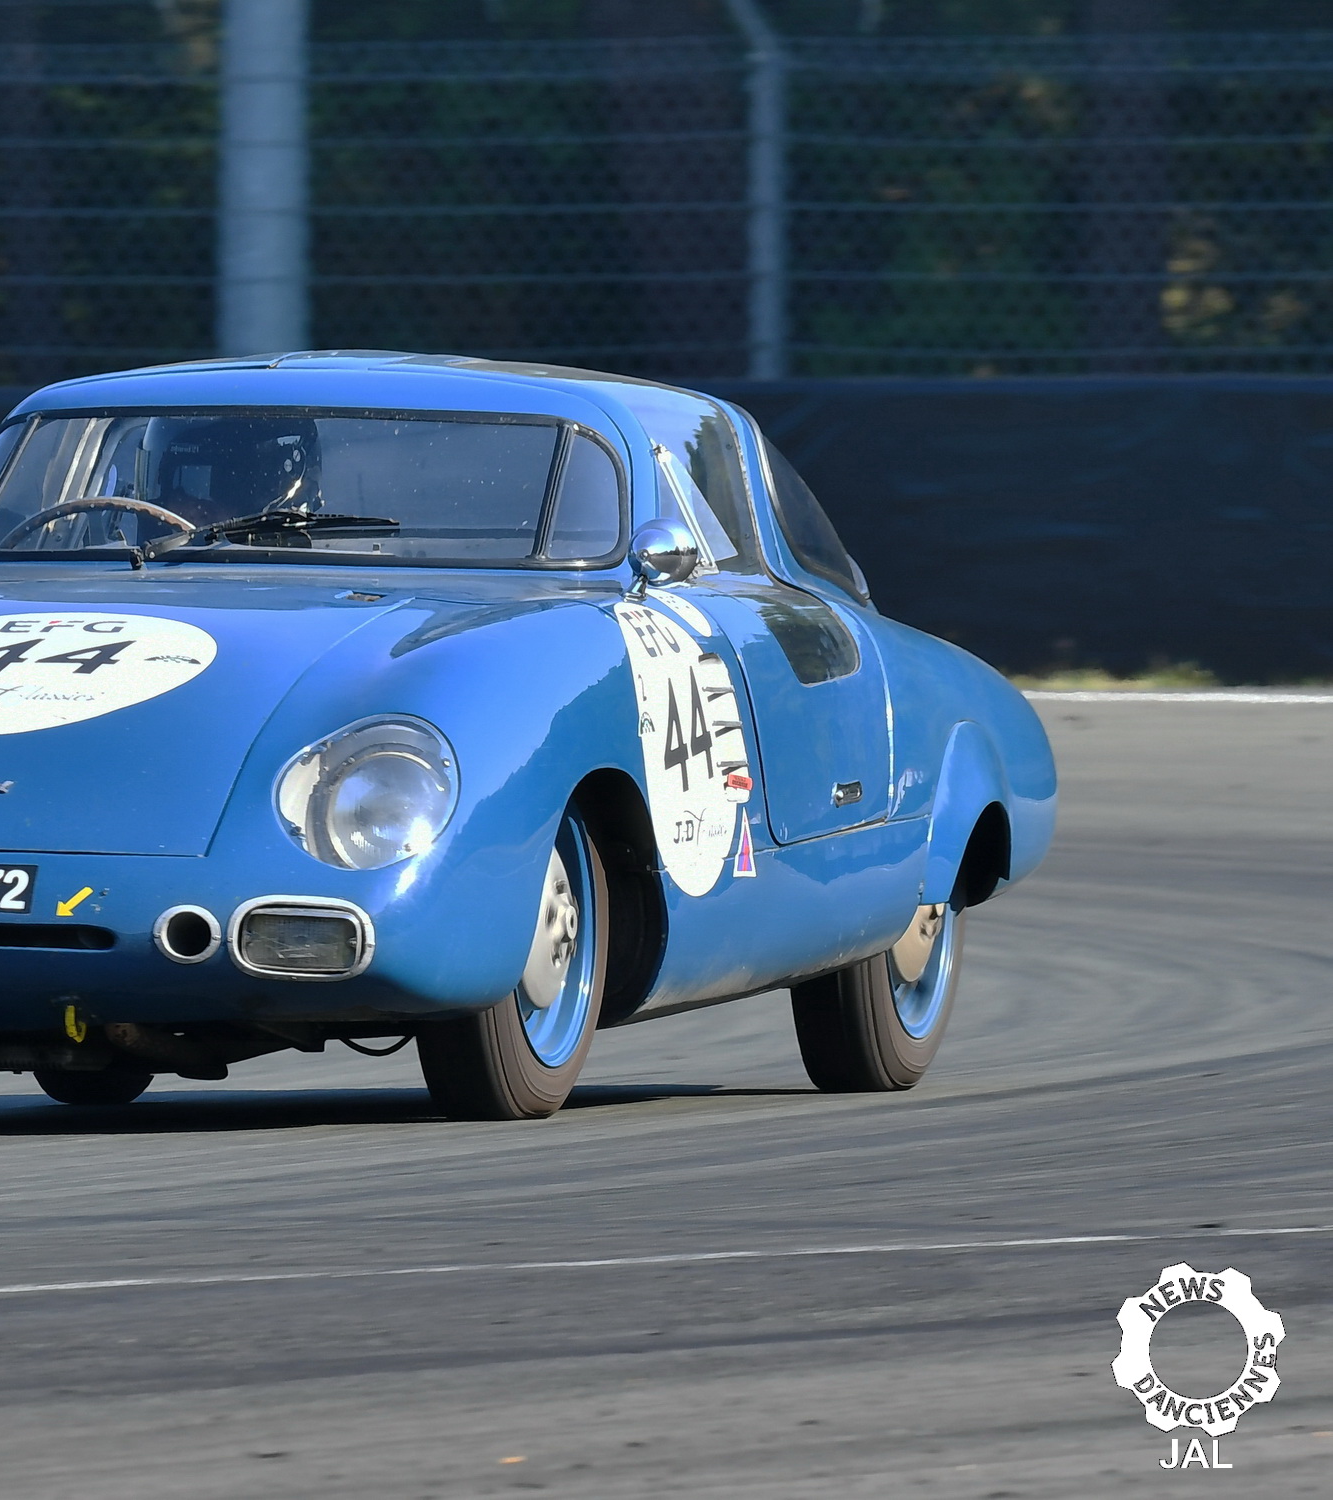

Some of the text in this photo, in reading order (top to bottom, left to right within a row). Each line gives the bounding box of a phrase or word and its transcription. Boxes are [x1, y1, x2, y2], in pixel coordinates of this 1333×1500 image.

[0, 620, 126, 633] EFG
[619, 609, 680, 657] EFG
[665, 665, 713, 792] 44
